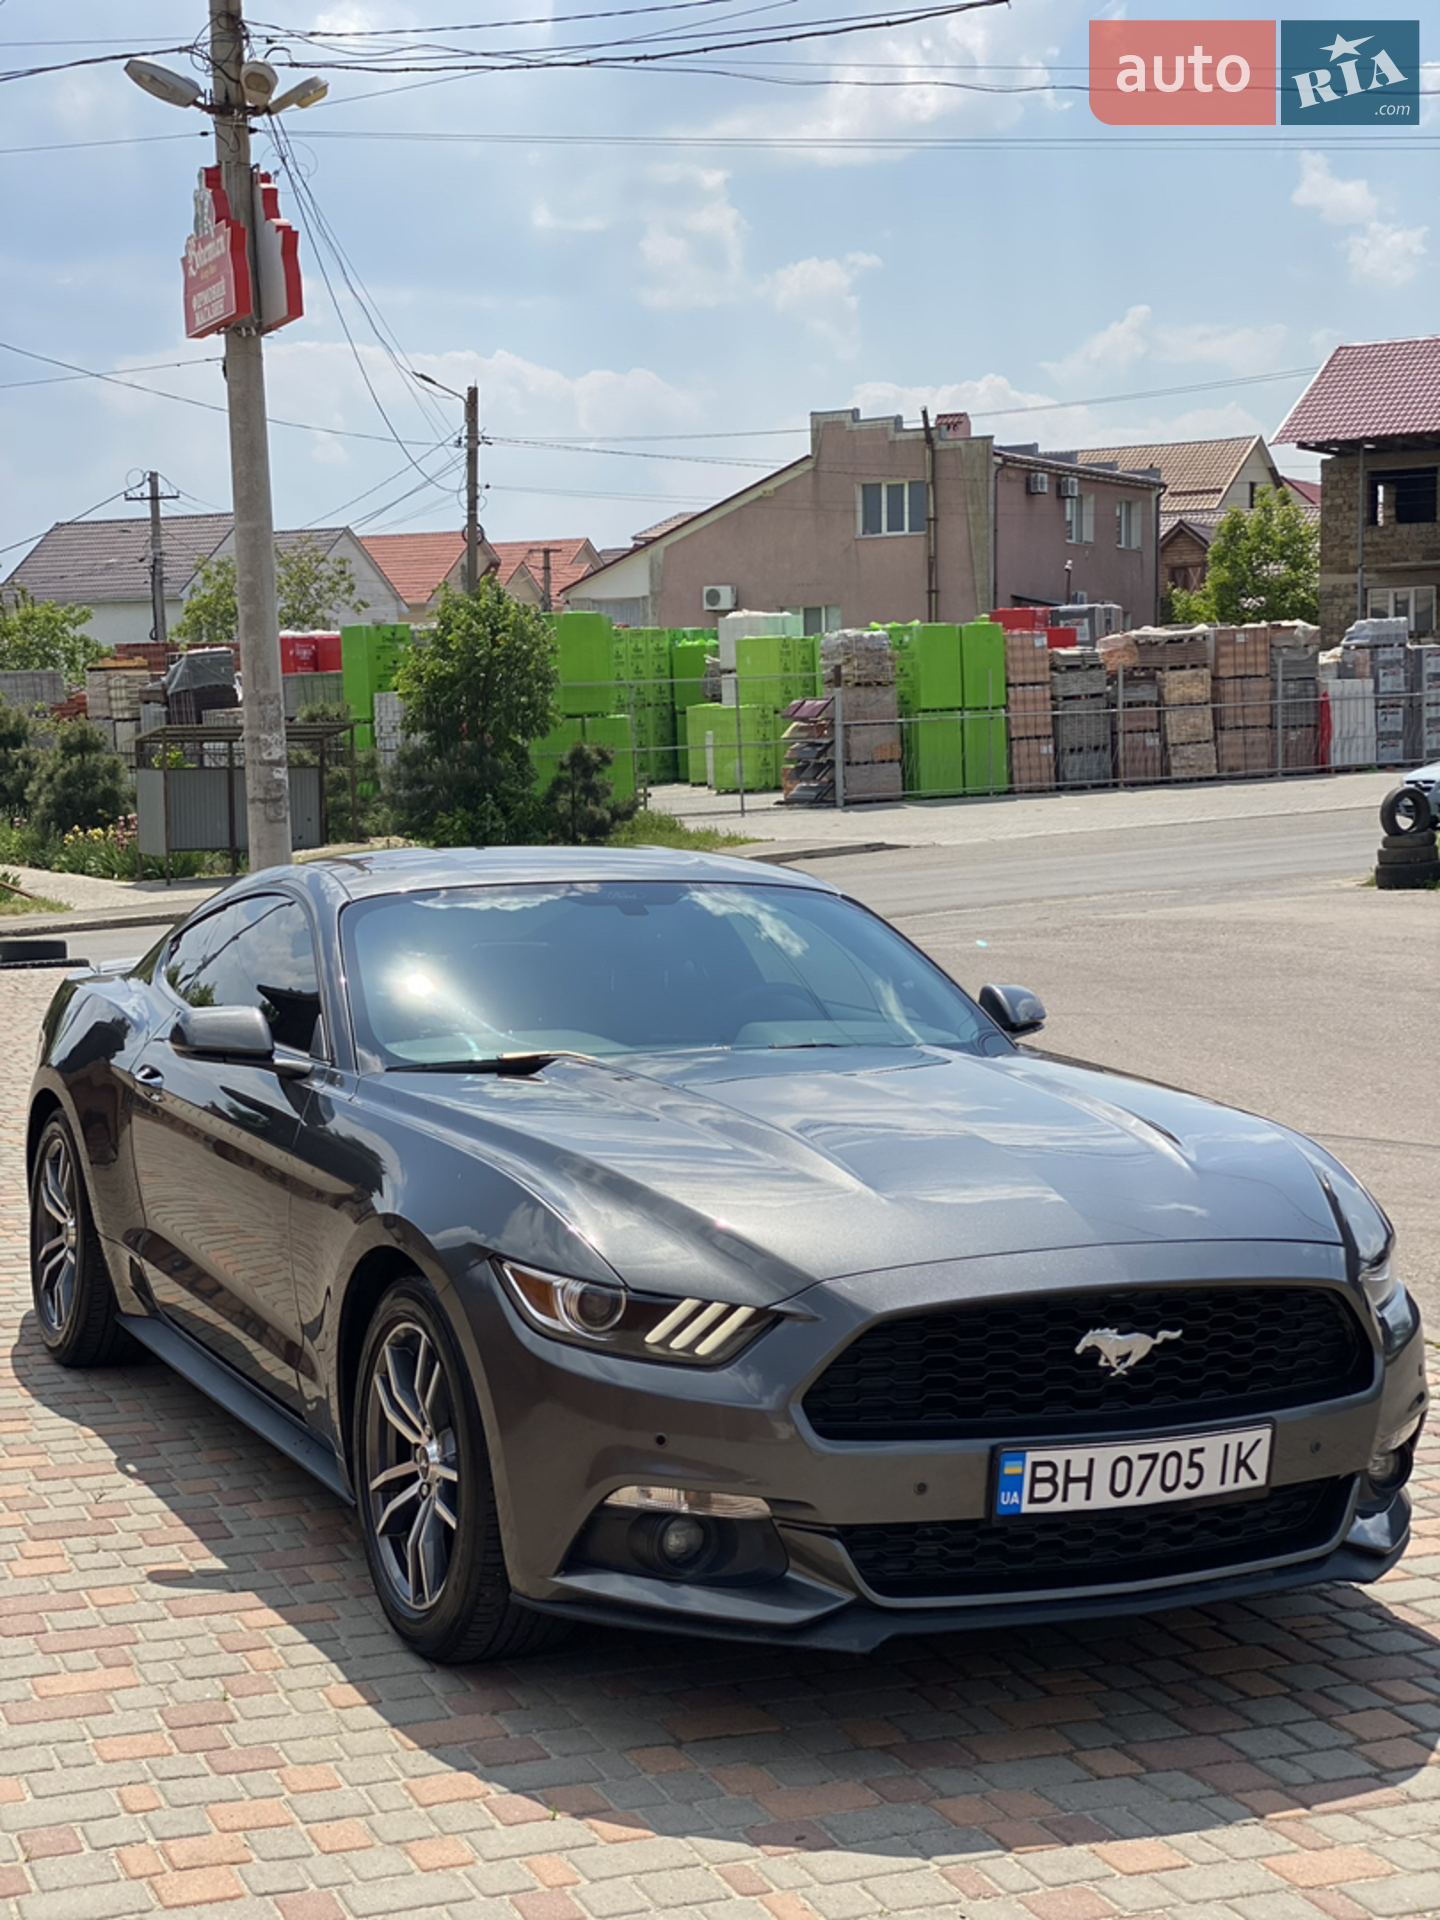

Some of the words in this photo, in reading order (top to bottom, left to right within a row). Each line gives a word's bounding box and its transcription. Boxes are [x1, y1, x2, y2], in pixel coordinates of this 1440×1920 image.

[1027, 1457, 1095, 1505] BH
[1109, 1446, 1206, 1498] 0705
[1219, 1437, 1263, 1486] IK
[1000, 1491, 1020, 1506] UA
